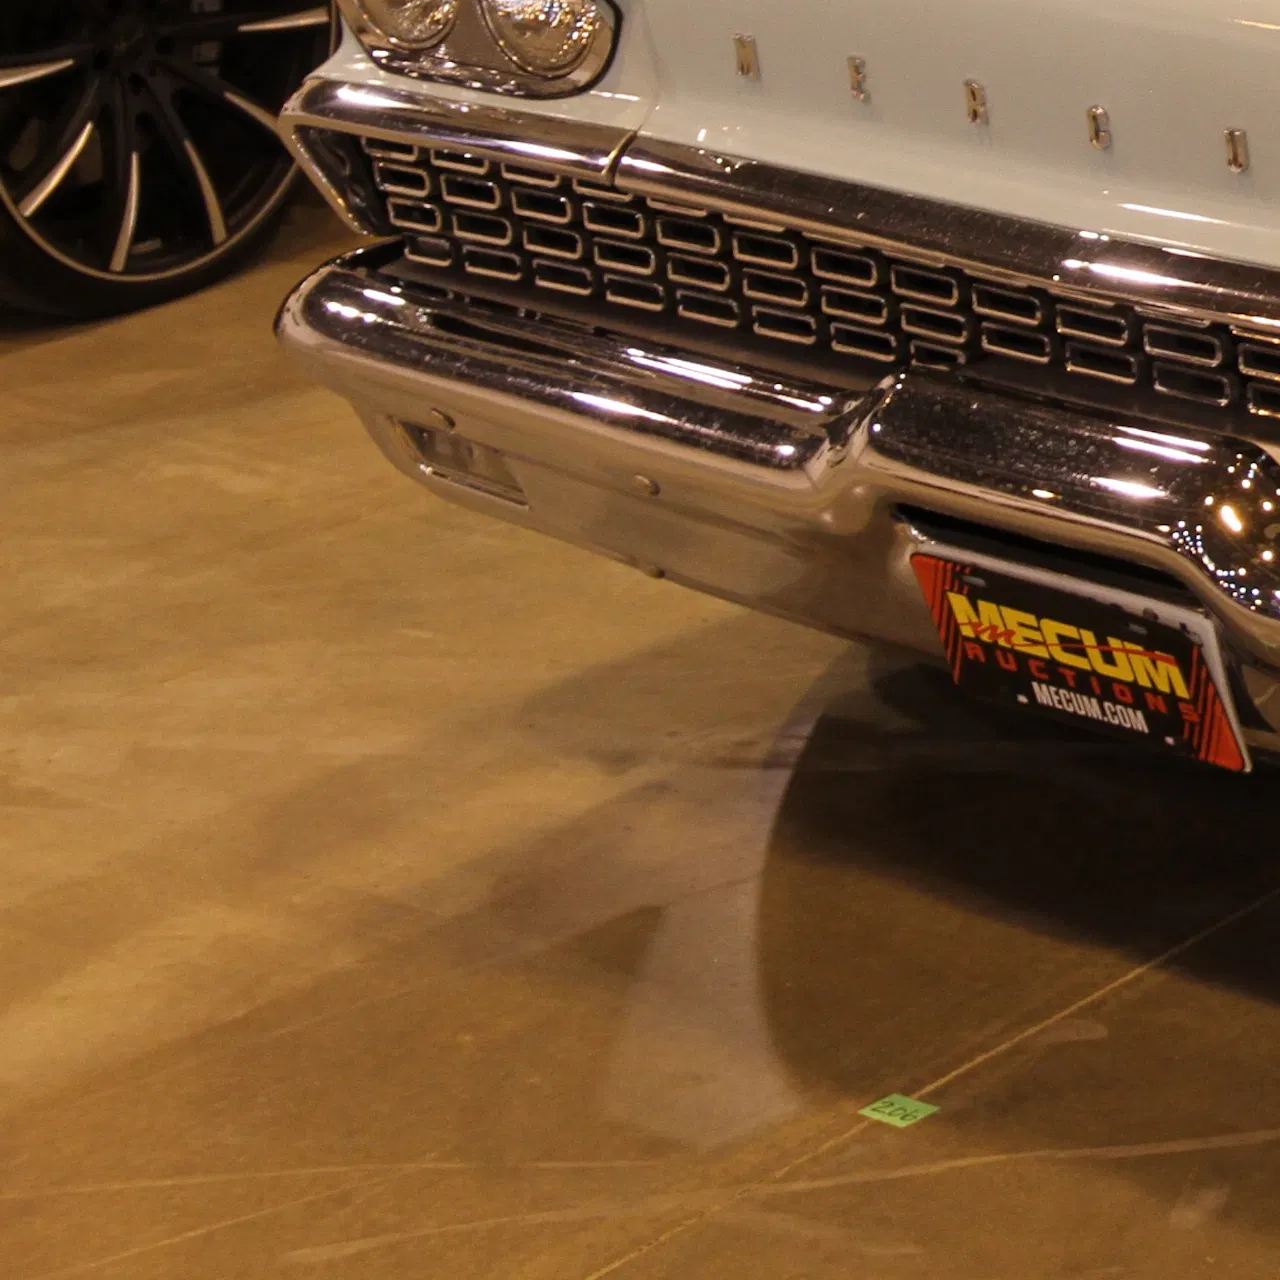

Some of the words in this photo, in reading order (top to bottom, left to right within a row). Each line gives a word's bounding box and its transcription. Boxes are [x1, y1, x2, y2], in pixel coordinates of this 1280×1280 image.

[946, 590, 1191, 700] MECUM
[963, 641, 1200, 721] AUCTIONS
[1031, 680, 1149, 734] MECUM.COM
